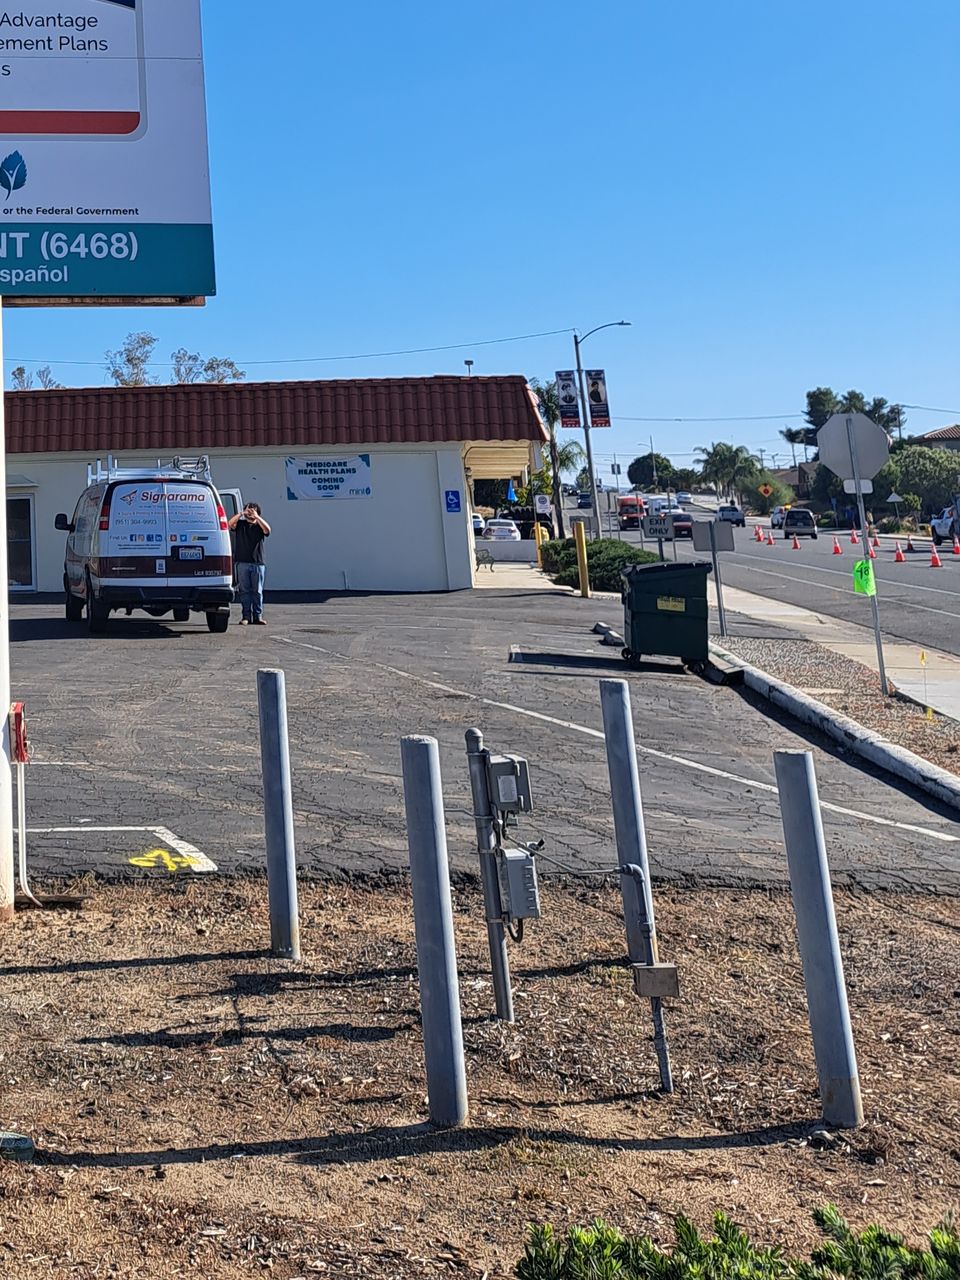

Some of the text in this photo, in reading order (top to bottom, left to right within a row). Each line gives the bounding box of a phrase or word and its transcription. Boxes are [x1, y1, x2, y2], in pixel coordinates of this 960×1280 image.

[0, 11, 99, 32] Advantage
[57, 34, 109, 52] Plans
[2, 208, 14, 216] or
[16, 206, 33, 216] the
[36, 206, 74, 216] Federal
[76, 206, 140, 217] Government
[40, 231, 139, 262] (6468)
[330, 467, 357, 475] PLANS
[141, 491, 205, 504] Signarama
[649, 518, 667, 526] EXIT
[648, 527, 670, 536] ONLY
